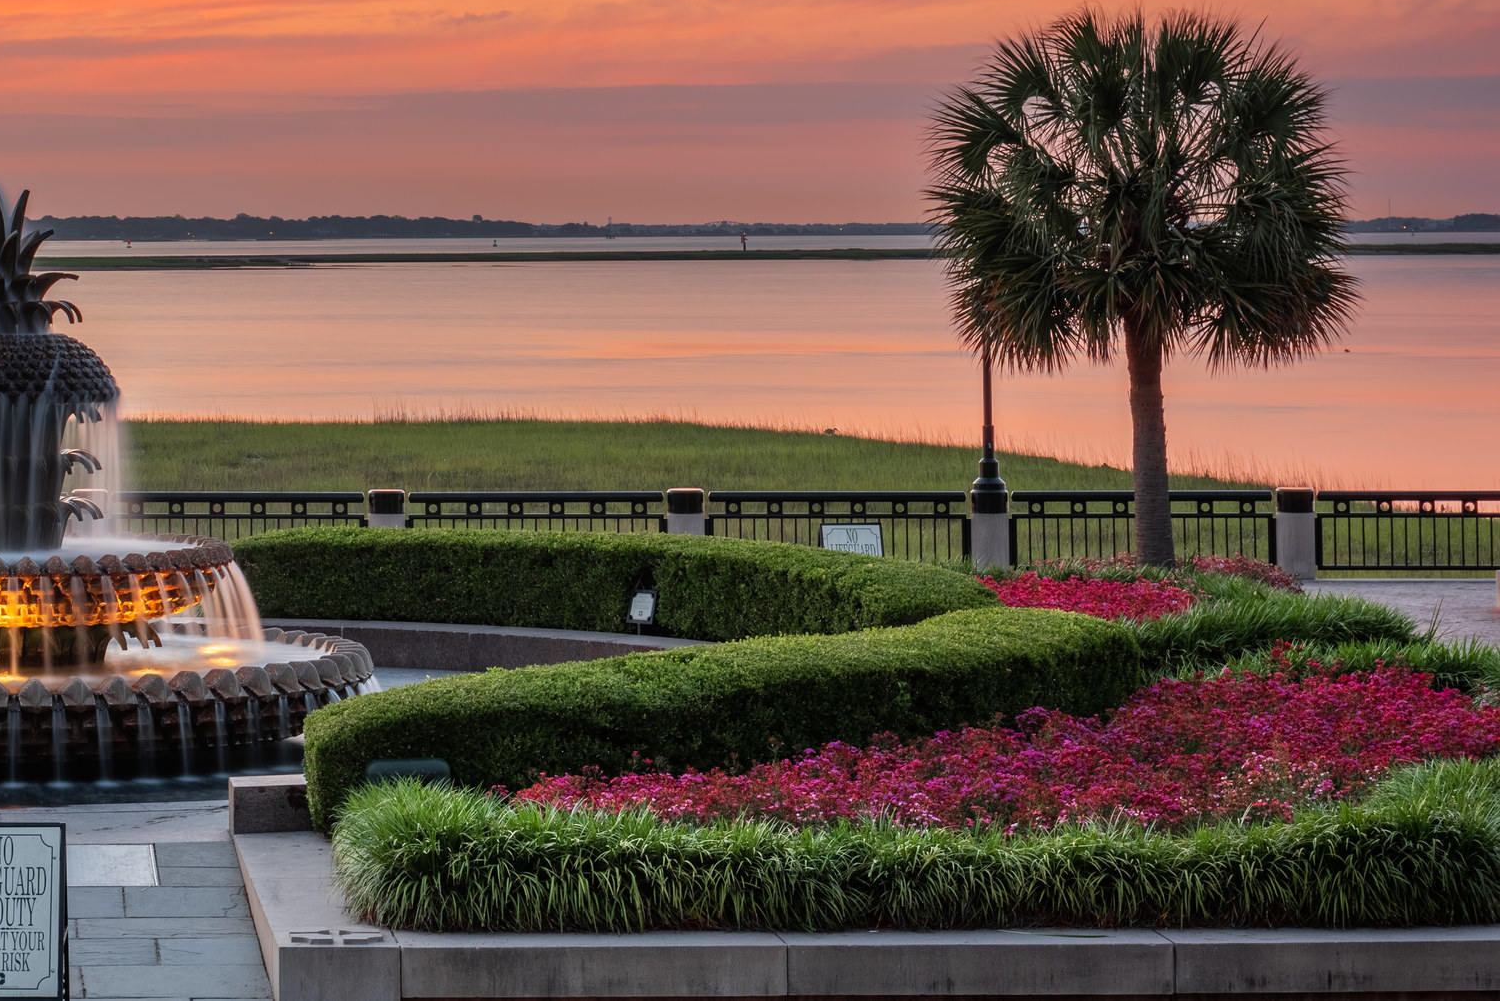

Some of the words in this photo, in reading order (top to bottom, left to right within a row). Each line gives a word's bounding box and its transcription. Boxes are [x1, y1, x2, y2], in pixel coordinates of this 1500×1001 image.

[846, 528, 858, 544] NO
[11, 931, 45, 951] YOUR
[2, 952, 31, 972] RISK
